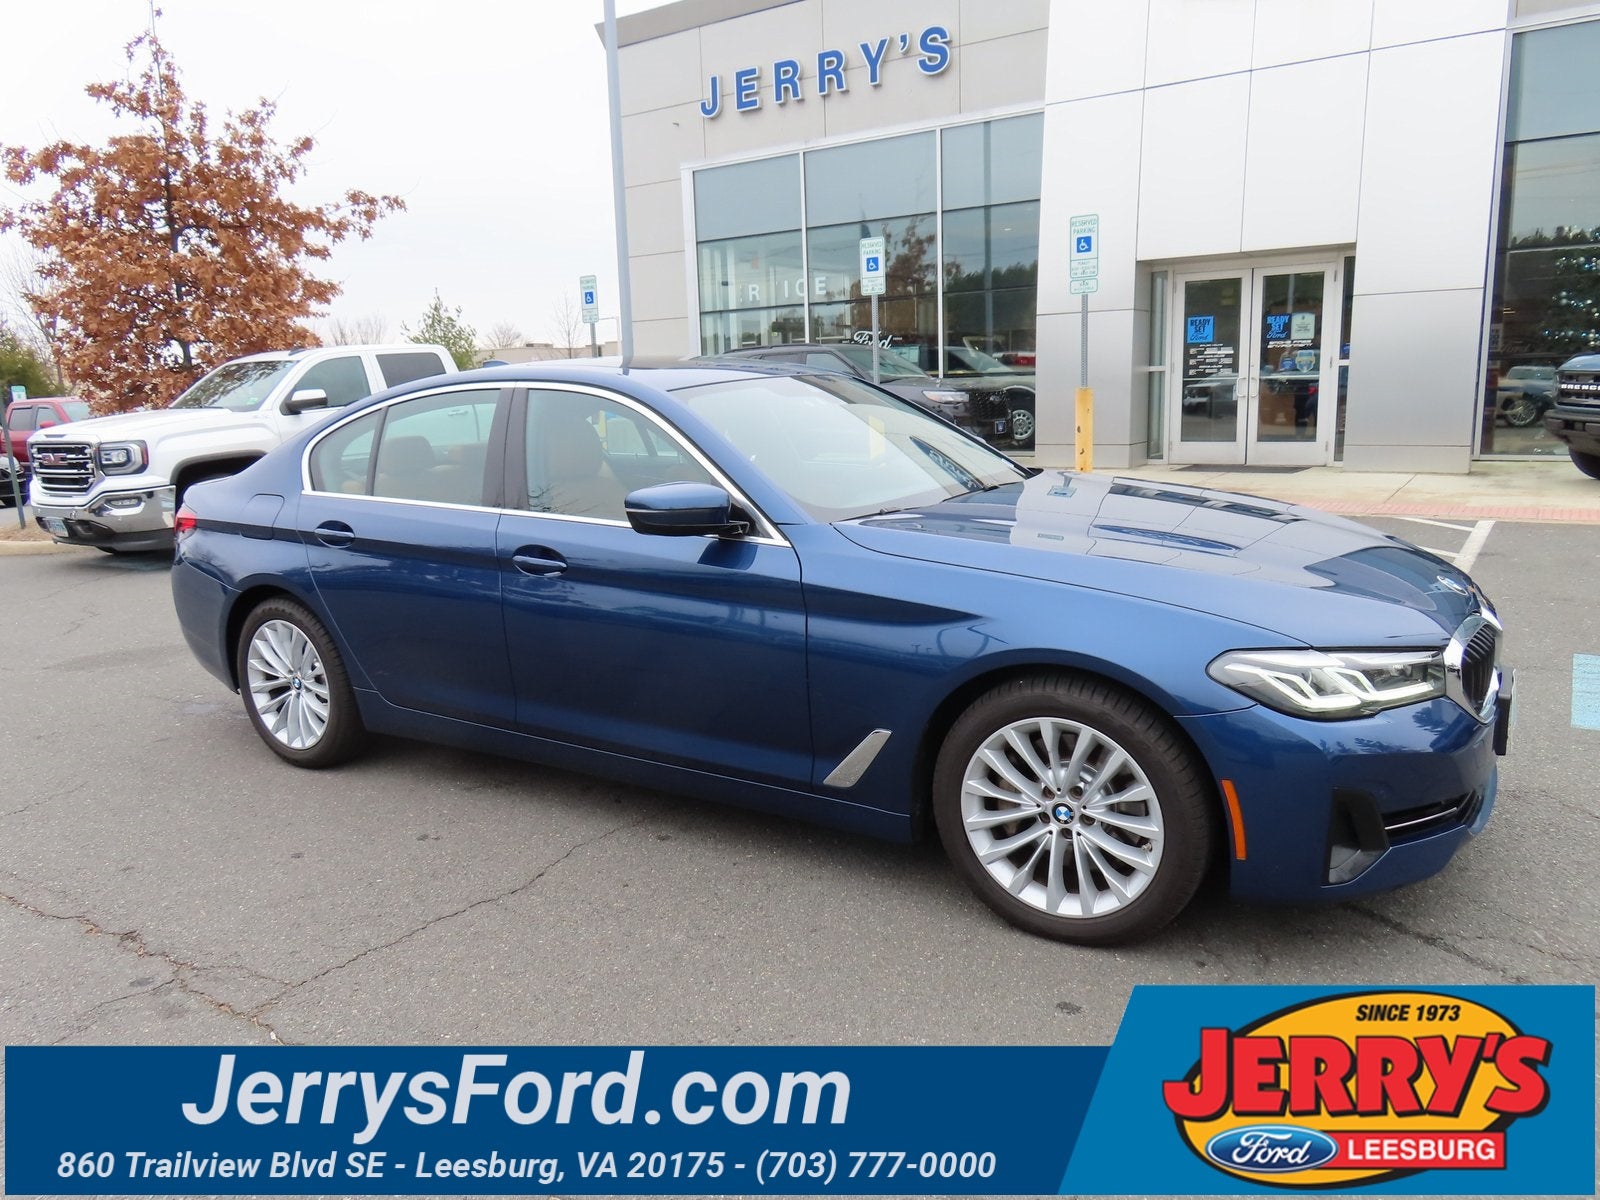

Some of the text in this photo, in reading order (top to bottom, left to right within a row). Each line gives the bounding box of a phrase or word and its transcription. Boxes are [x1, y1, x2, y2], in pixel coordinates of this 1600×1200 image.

[700, 25, 950, 118] JERRY'S
[1073, 227, 1096, 235] PARKING
[1190, 318, 1211, 326] READY
[1266, 315, 1290, 324] READY
[1194, 325, 1206, 333] SET
[1271, 321, 1284, 333] SET
